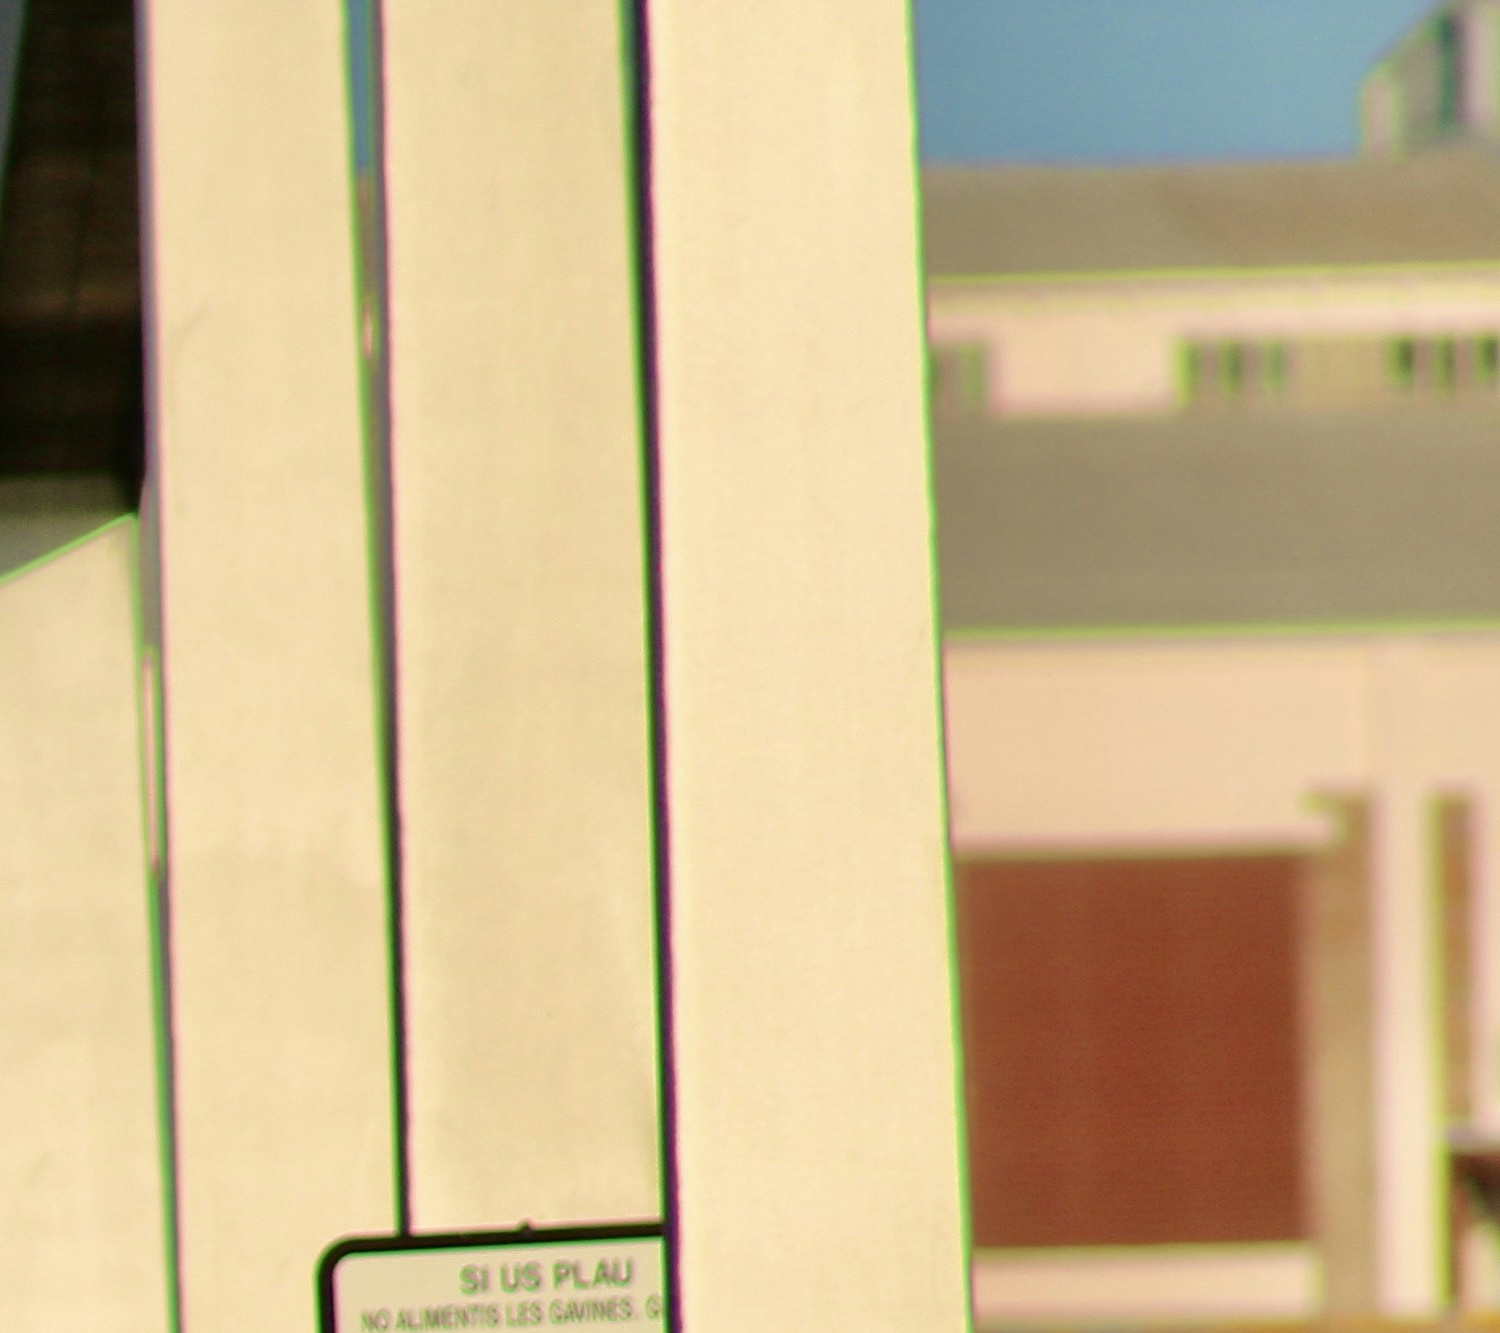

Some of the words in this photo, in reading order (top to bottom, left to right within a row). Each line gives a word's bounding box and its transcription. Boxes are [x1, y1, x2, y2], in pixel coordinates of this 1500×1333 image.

[460, 1266, 489, 1295] SI
[500, 1262, 542, 1293] US
[552, 1258, 633, 1290] PLAU
[360, 1309, 390, 1333] NO
[505, 1301, 543, 1326] LES
